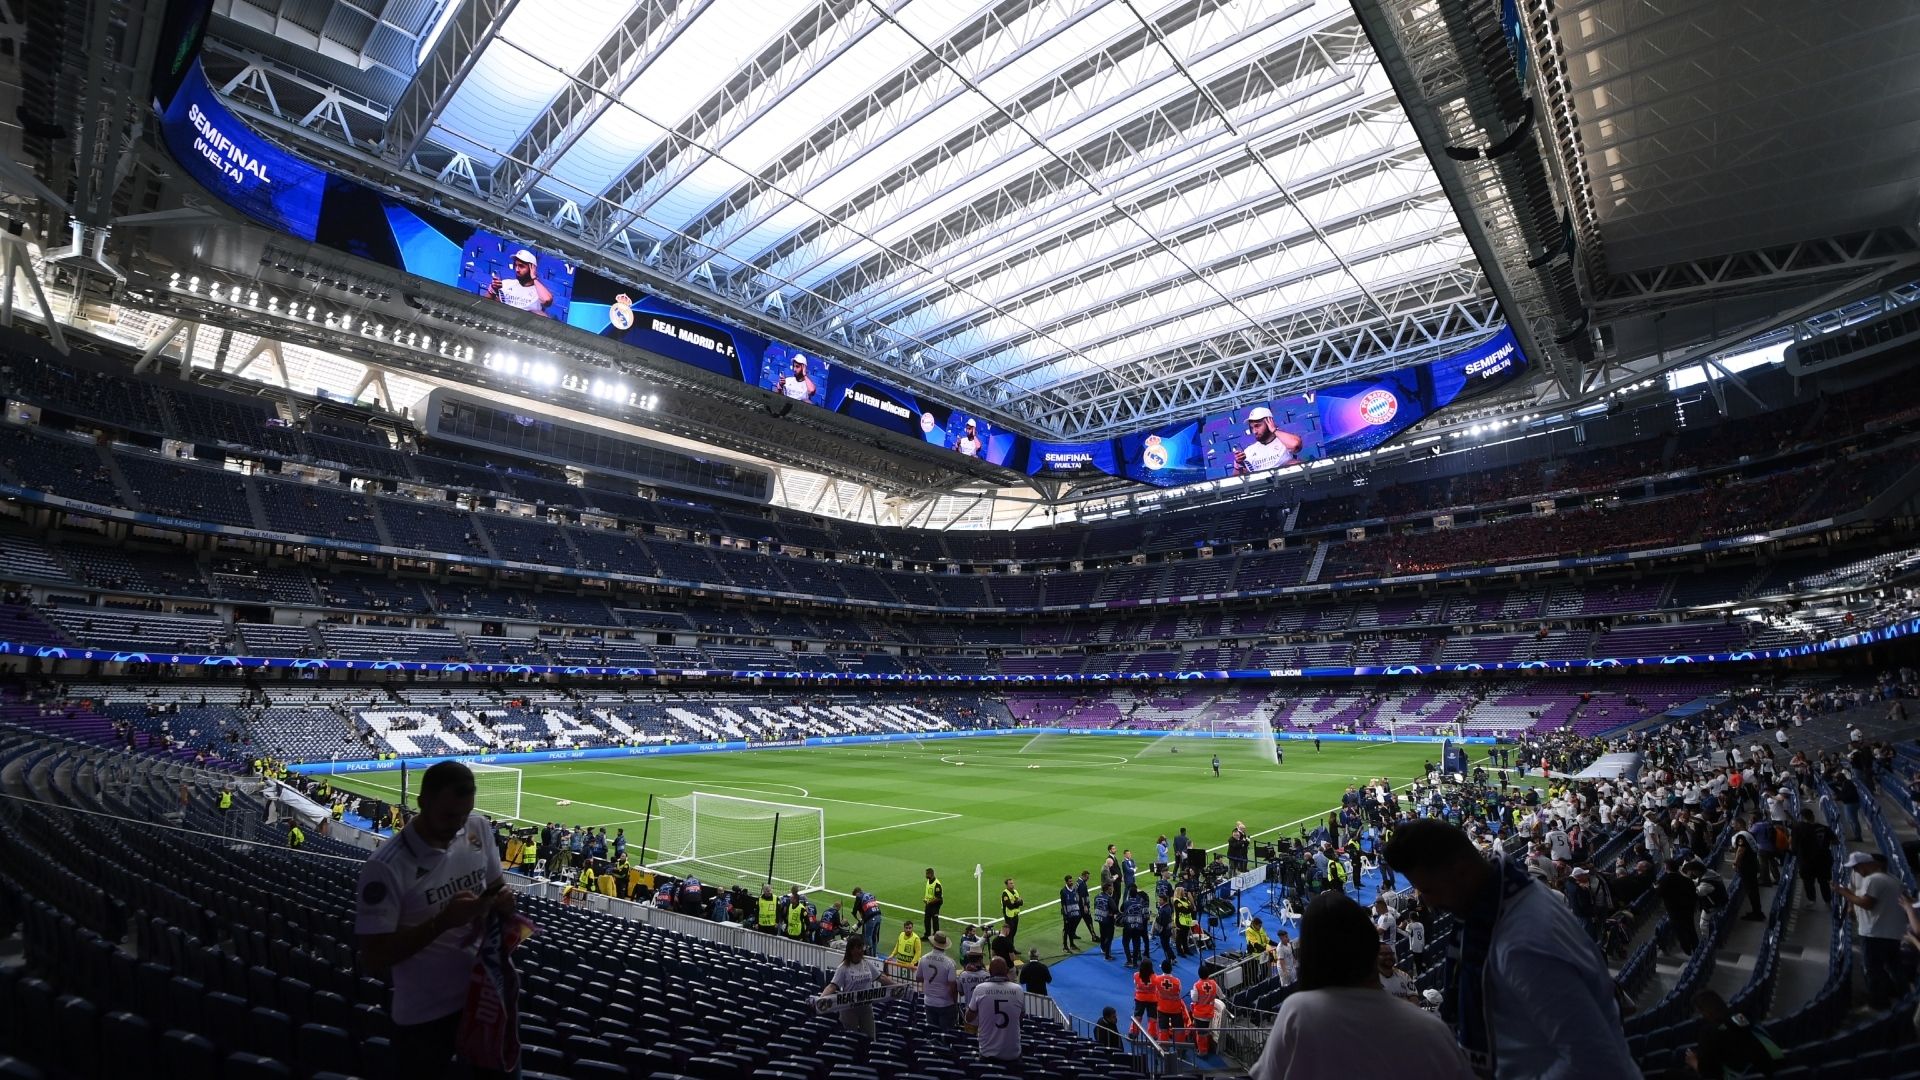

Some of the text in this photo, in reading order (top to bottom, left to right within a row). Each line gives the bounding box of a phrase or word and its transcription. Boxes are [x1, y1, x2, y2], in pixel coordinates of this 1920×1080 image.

[189, 104, 271, 183] SEMIFINAL
[193, 137, 244, 184] (VUELTA)
[652, 319, 736, 358] REAL MADRID C. F.
[1465, 342, 1514, 375] SEMIFINAL
[1482, 358, 1511, 379] (VUELTA)
[845, 387, 910, 419] FC BAYERN MÜNCHEN
[1045, 453, 1092, 462] SEMIFINAL
[66, 500, 112, 516] Real Madrid
[157, 517, 201, 529] Real Madrid
[243, 529, 287, 541] Real Madrid
[325, 539, 362, 550] Real Madrid
[1269, 669, 1302, 677] WELKOM
[346, 763, 370, 771] PEACE
[424, 869, 487, 905] Emirate
[928, 964, 939, 984] 7
[837, 991, 855, 1005] REAL
[856, 987, 887, 1003] MADRID
[994, 999, 1010, 1029] 5
